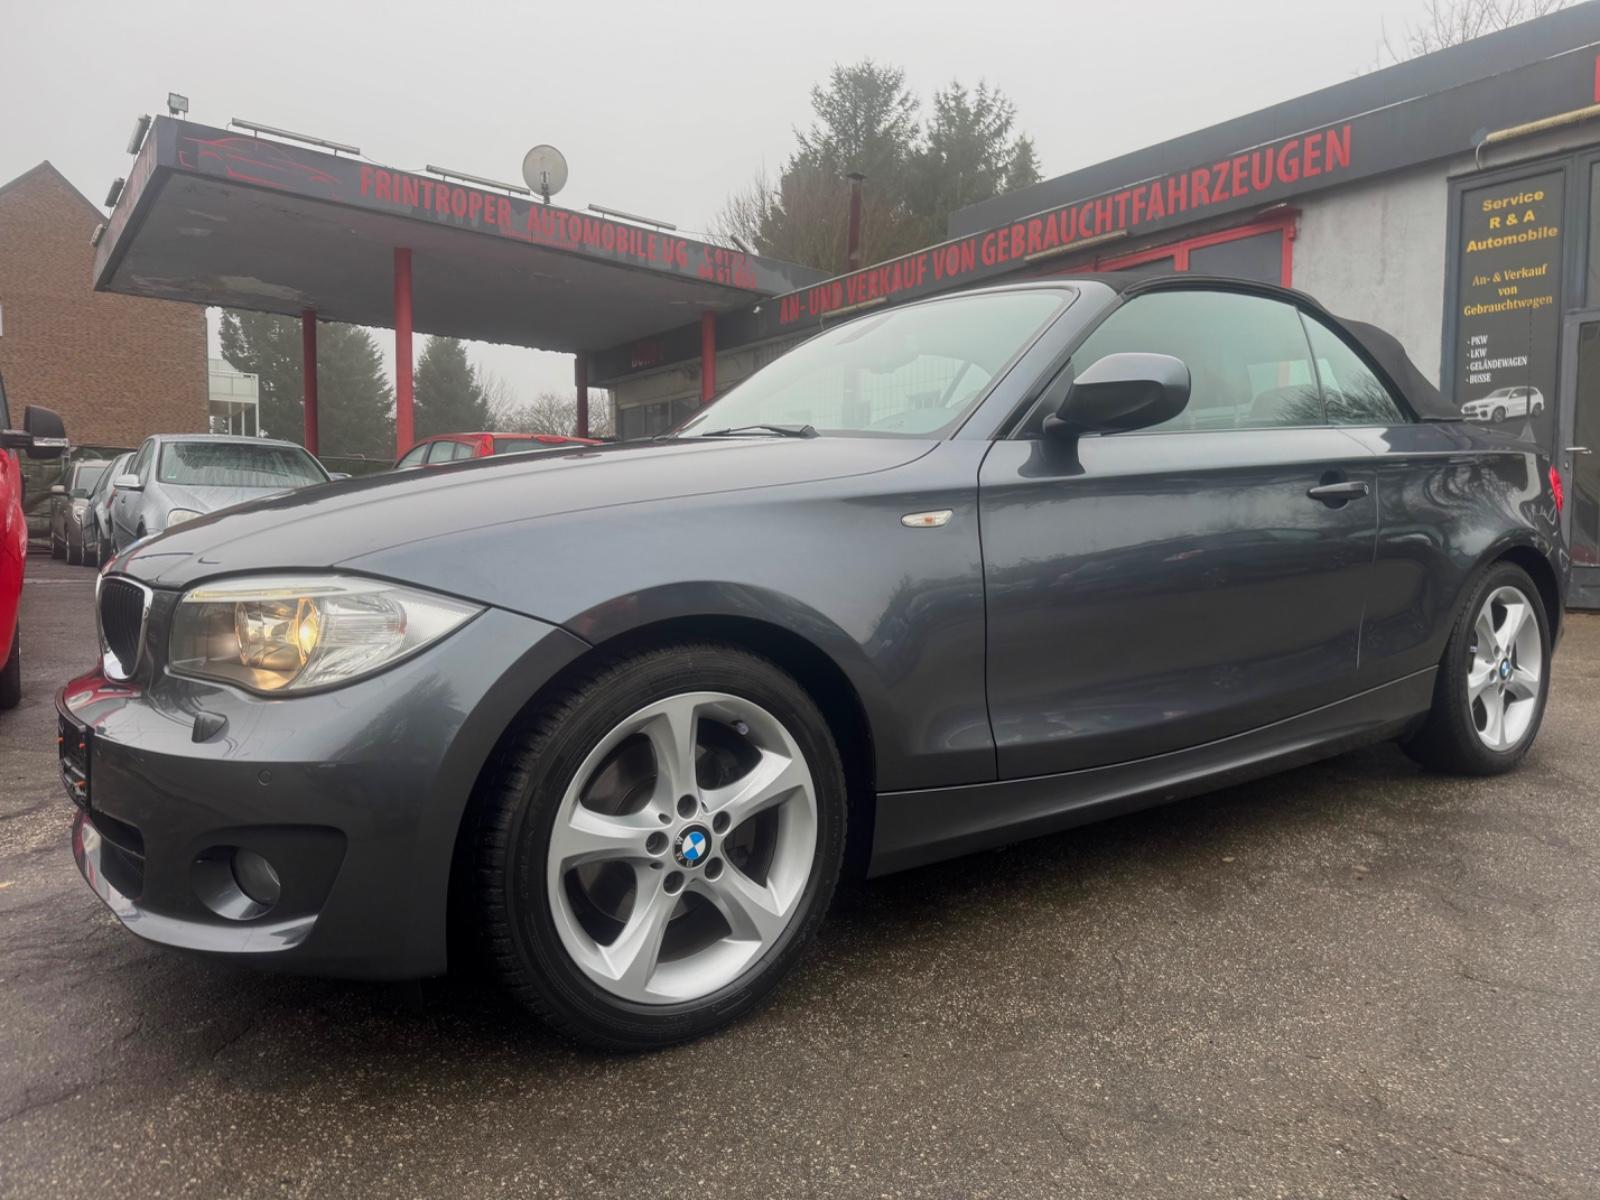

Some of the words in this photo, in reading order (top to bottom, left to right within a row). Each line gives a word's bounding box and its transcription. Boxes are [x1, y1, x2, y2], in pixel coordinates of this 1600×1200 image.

[1482, 190, 1545, 212] Service
[359, 166, 512, 227] FRINTROPER
[527, 205, 657, 261] AUTOMOBILE
[663, 236, 689, 268] UG
[779, 295, 806, 325] AN-
[809, 280, 844, 316] UND
[847, 253, 929, 305] VERKAUF
[932, 239, 976, 281] VON
[981, 123, 1353, 267] GEBRAUCHTFAHRZEUGEN
[1489, 216, 1501, 229] R
[1506, 213, 1518, 226] &
[1523, 209, 1536, 223] A
[1466, 226, 1559, 253] Automobile
[1492, 272, 1502, 283] &
[1504, 263, 1548, 281] Verkauf
[1498, 285, 1518, 297] von
[1464, 295, 1553, 317] Gebrauchtwagen
